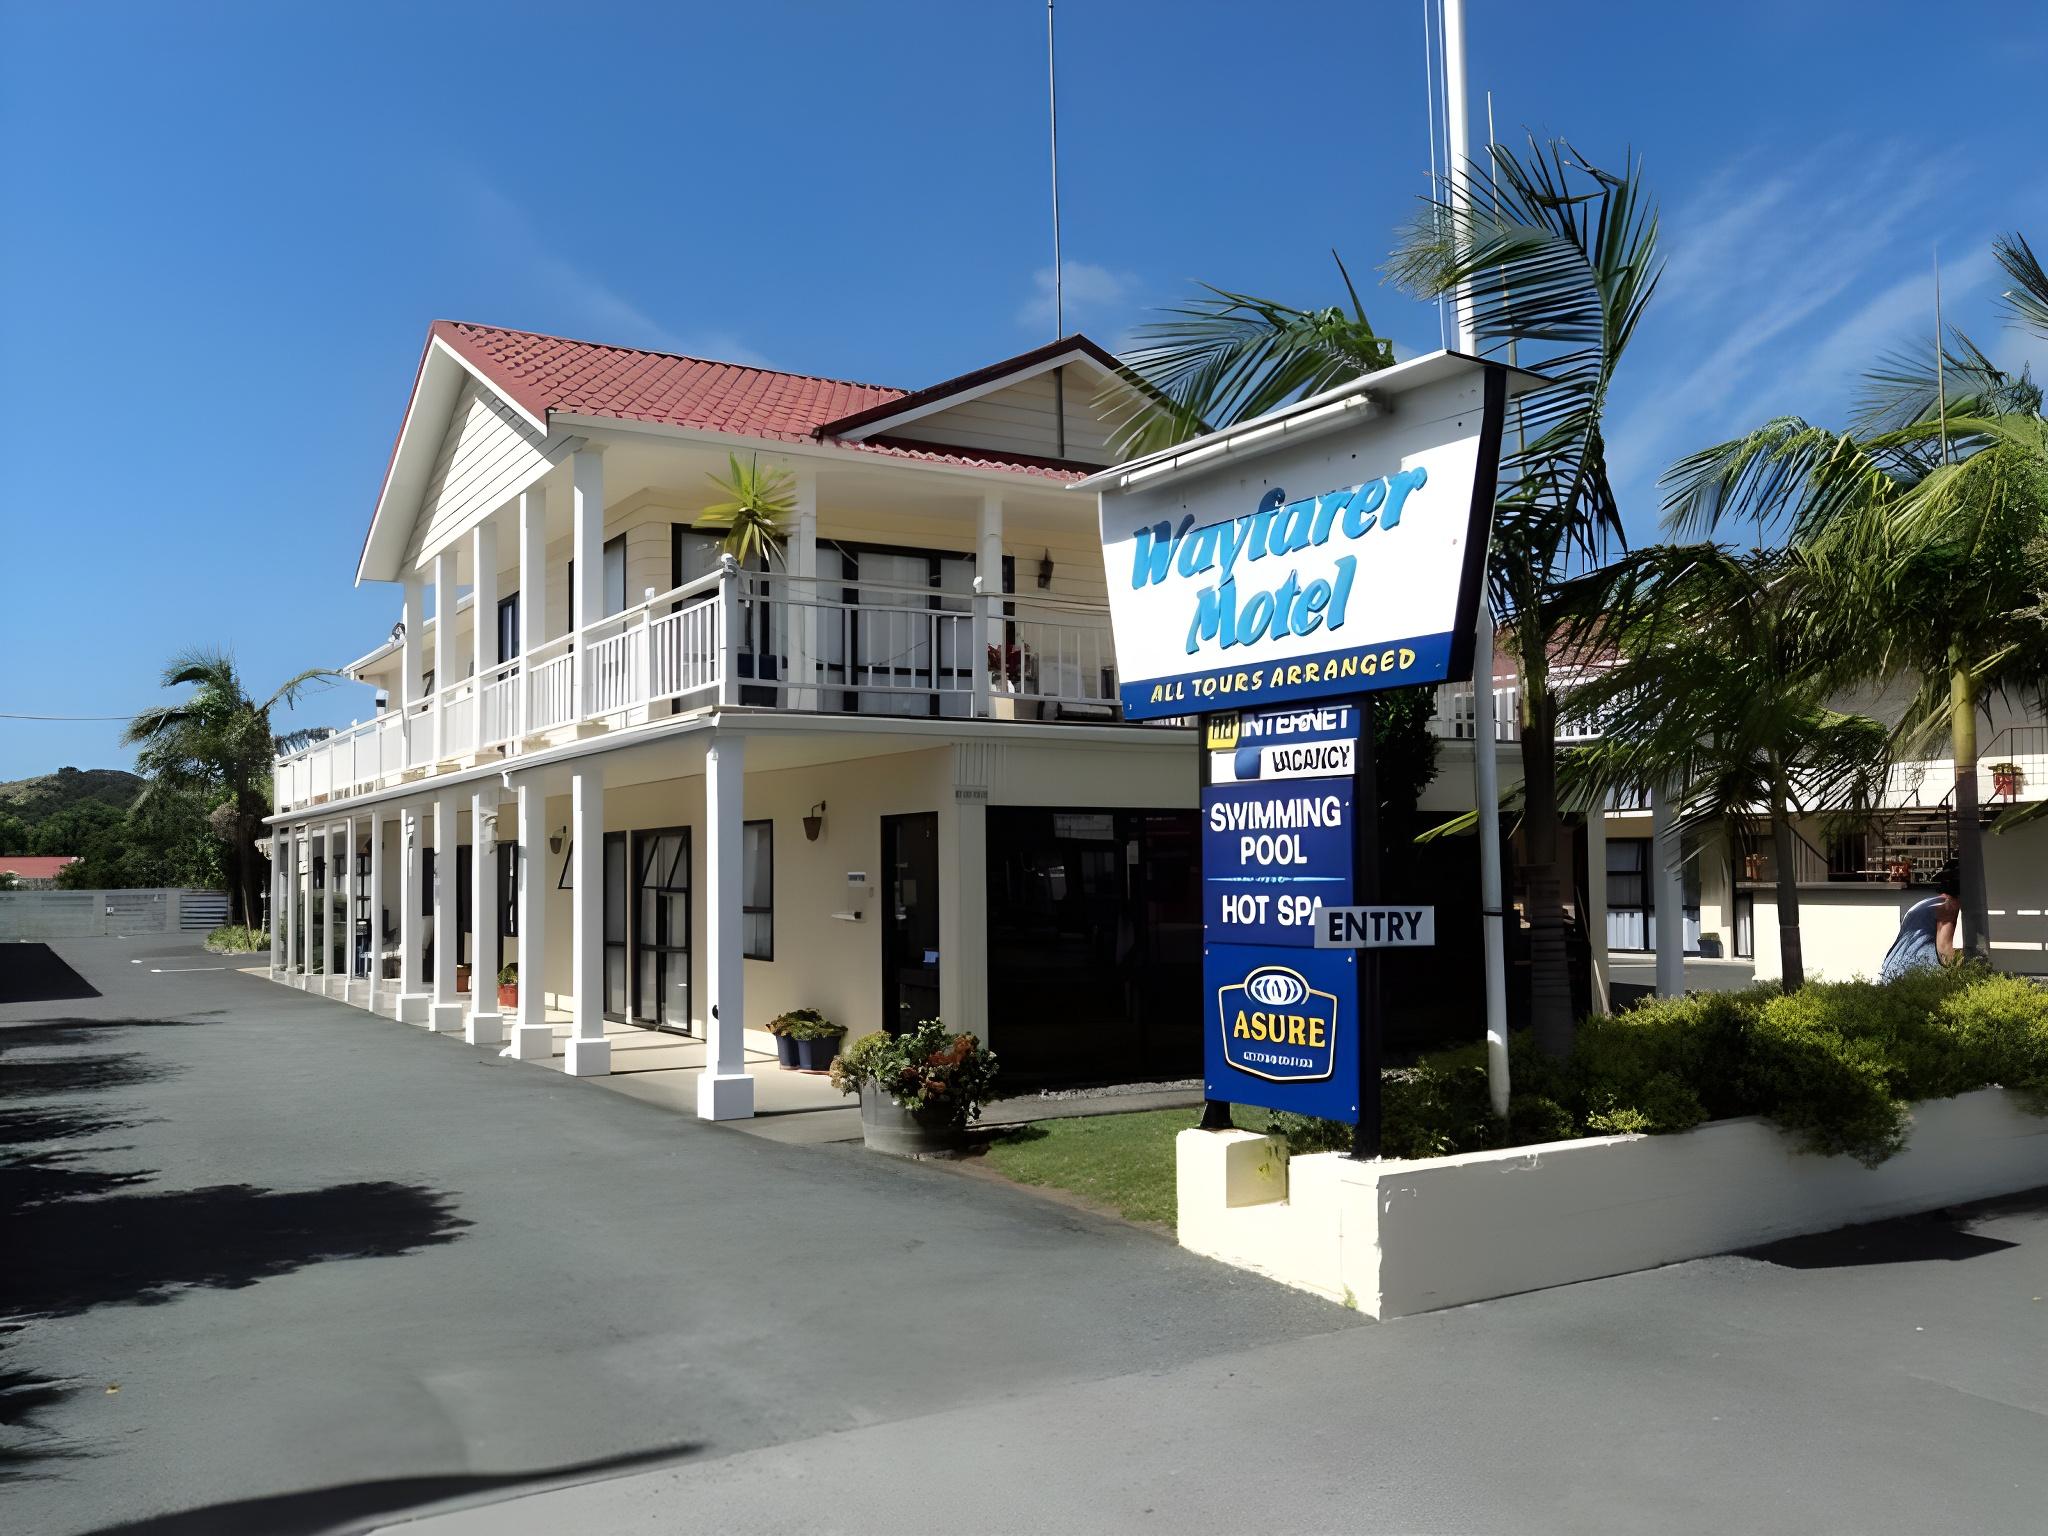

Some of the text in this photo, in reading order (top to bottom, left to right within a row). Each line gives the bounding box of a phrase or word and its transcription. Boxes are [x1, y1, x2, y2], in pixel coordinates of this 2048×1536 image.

[1132, 466, 1428, 590] Wayfarer
[1186, 554, 1357, 655] Motel
[1150, 648, 1416, 703] ALL TOURS ARRANGED
[1210, 796, 1342, 832] SWIMMING
[1240, 834, 1308, 866] POOL
[1222, 894, 1270, 925] HOT
[1328, 911, 1423, 942] ENTRY
[1233, 1010, 1326, 1048] ASURE
